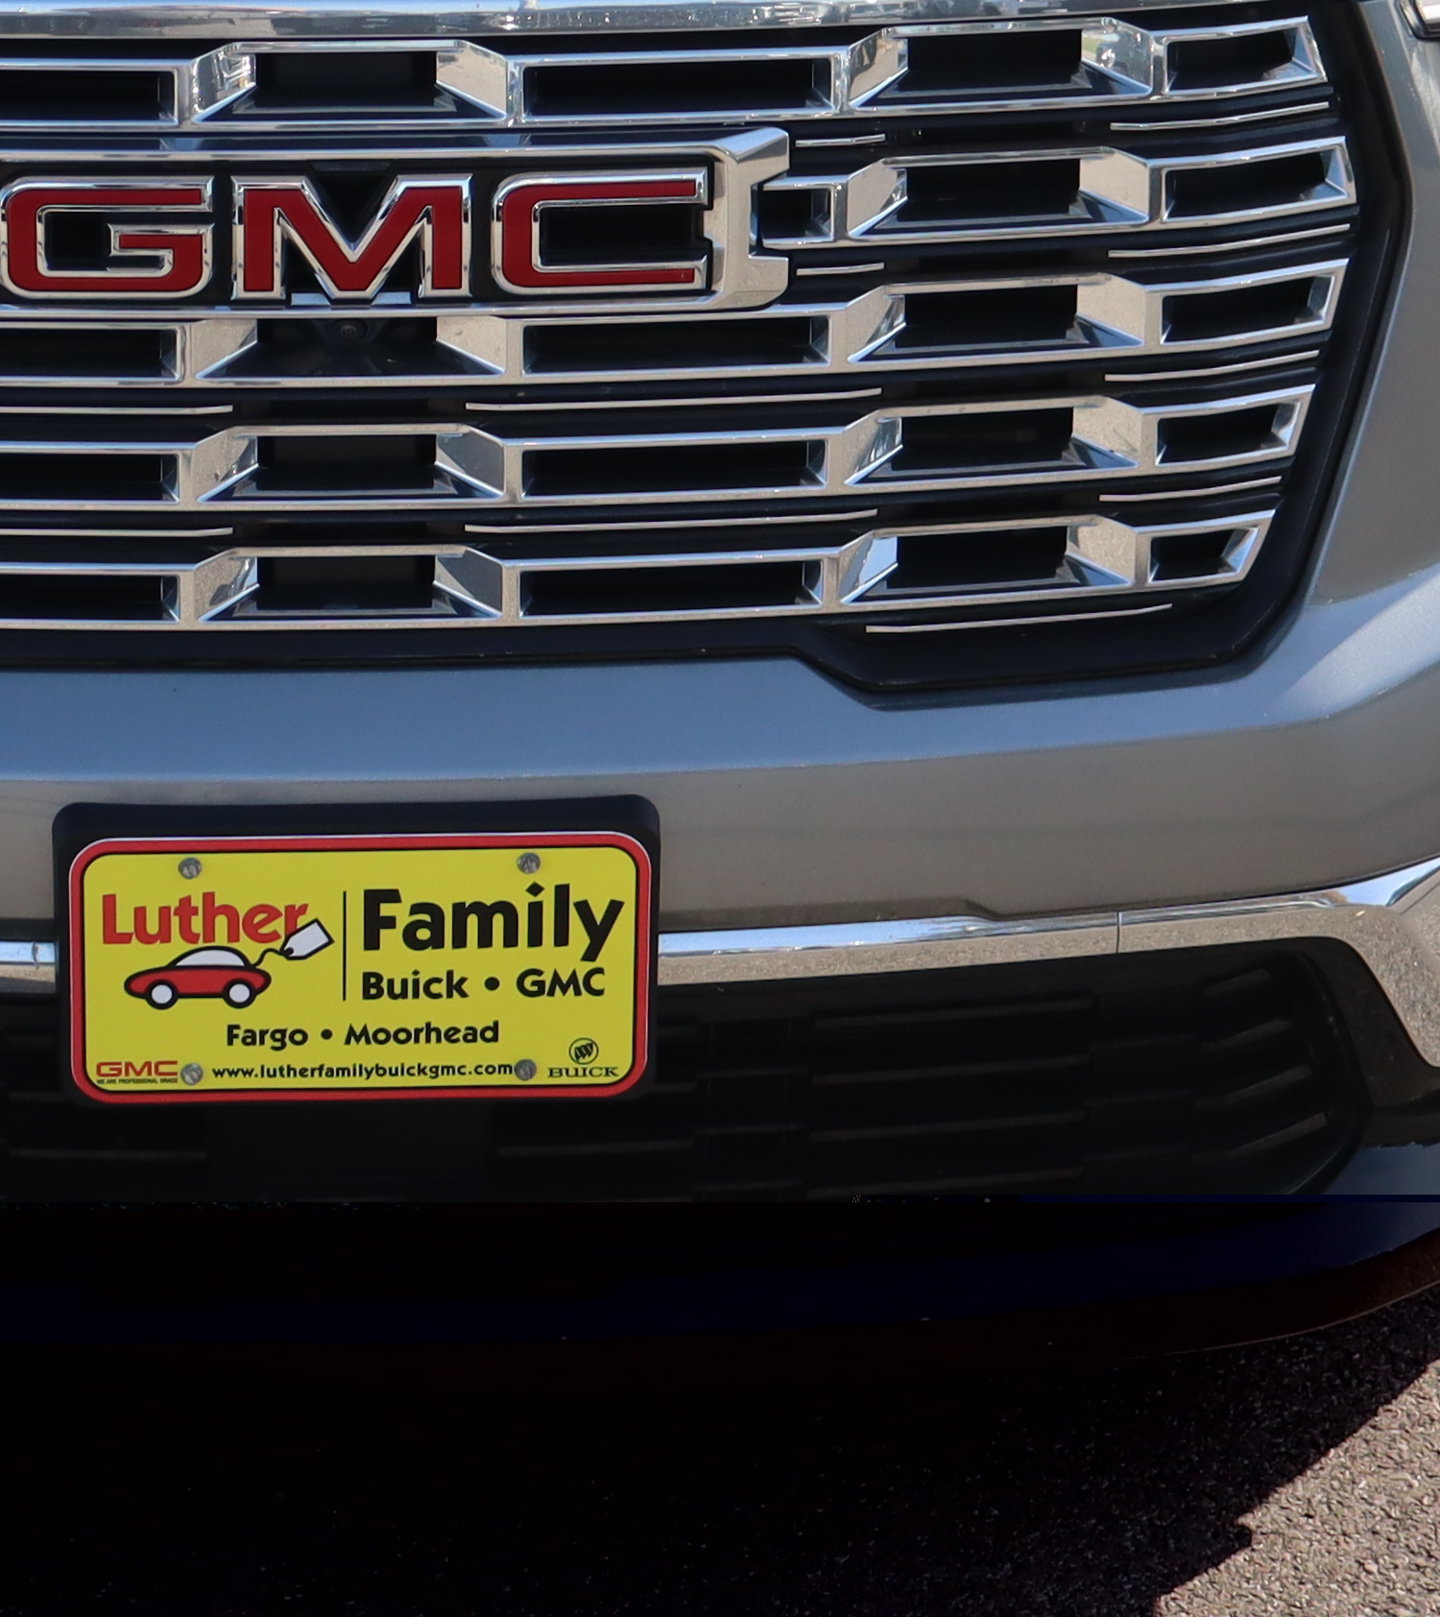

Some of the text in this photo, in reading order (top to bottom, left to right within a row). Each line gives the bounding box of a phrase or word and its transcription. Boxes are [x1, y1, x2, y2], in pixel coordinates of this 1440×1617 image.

[102, 891, 309, 945] Luther
[363, 881, 625, 963] Family
[362, 967, 606, 1001] Buick GMC
[226, 1020, 500, 1052] Fargo Moorhead
[96, 1060, 179, 1078] GMC
[212, 1063, 514, 1080] www.lutherfamilybuickgmc.com
[547, 1065, 620, 1079] BUICK
